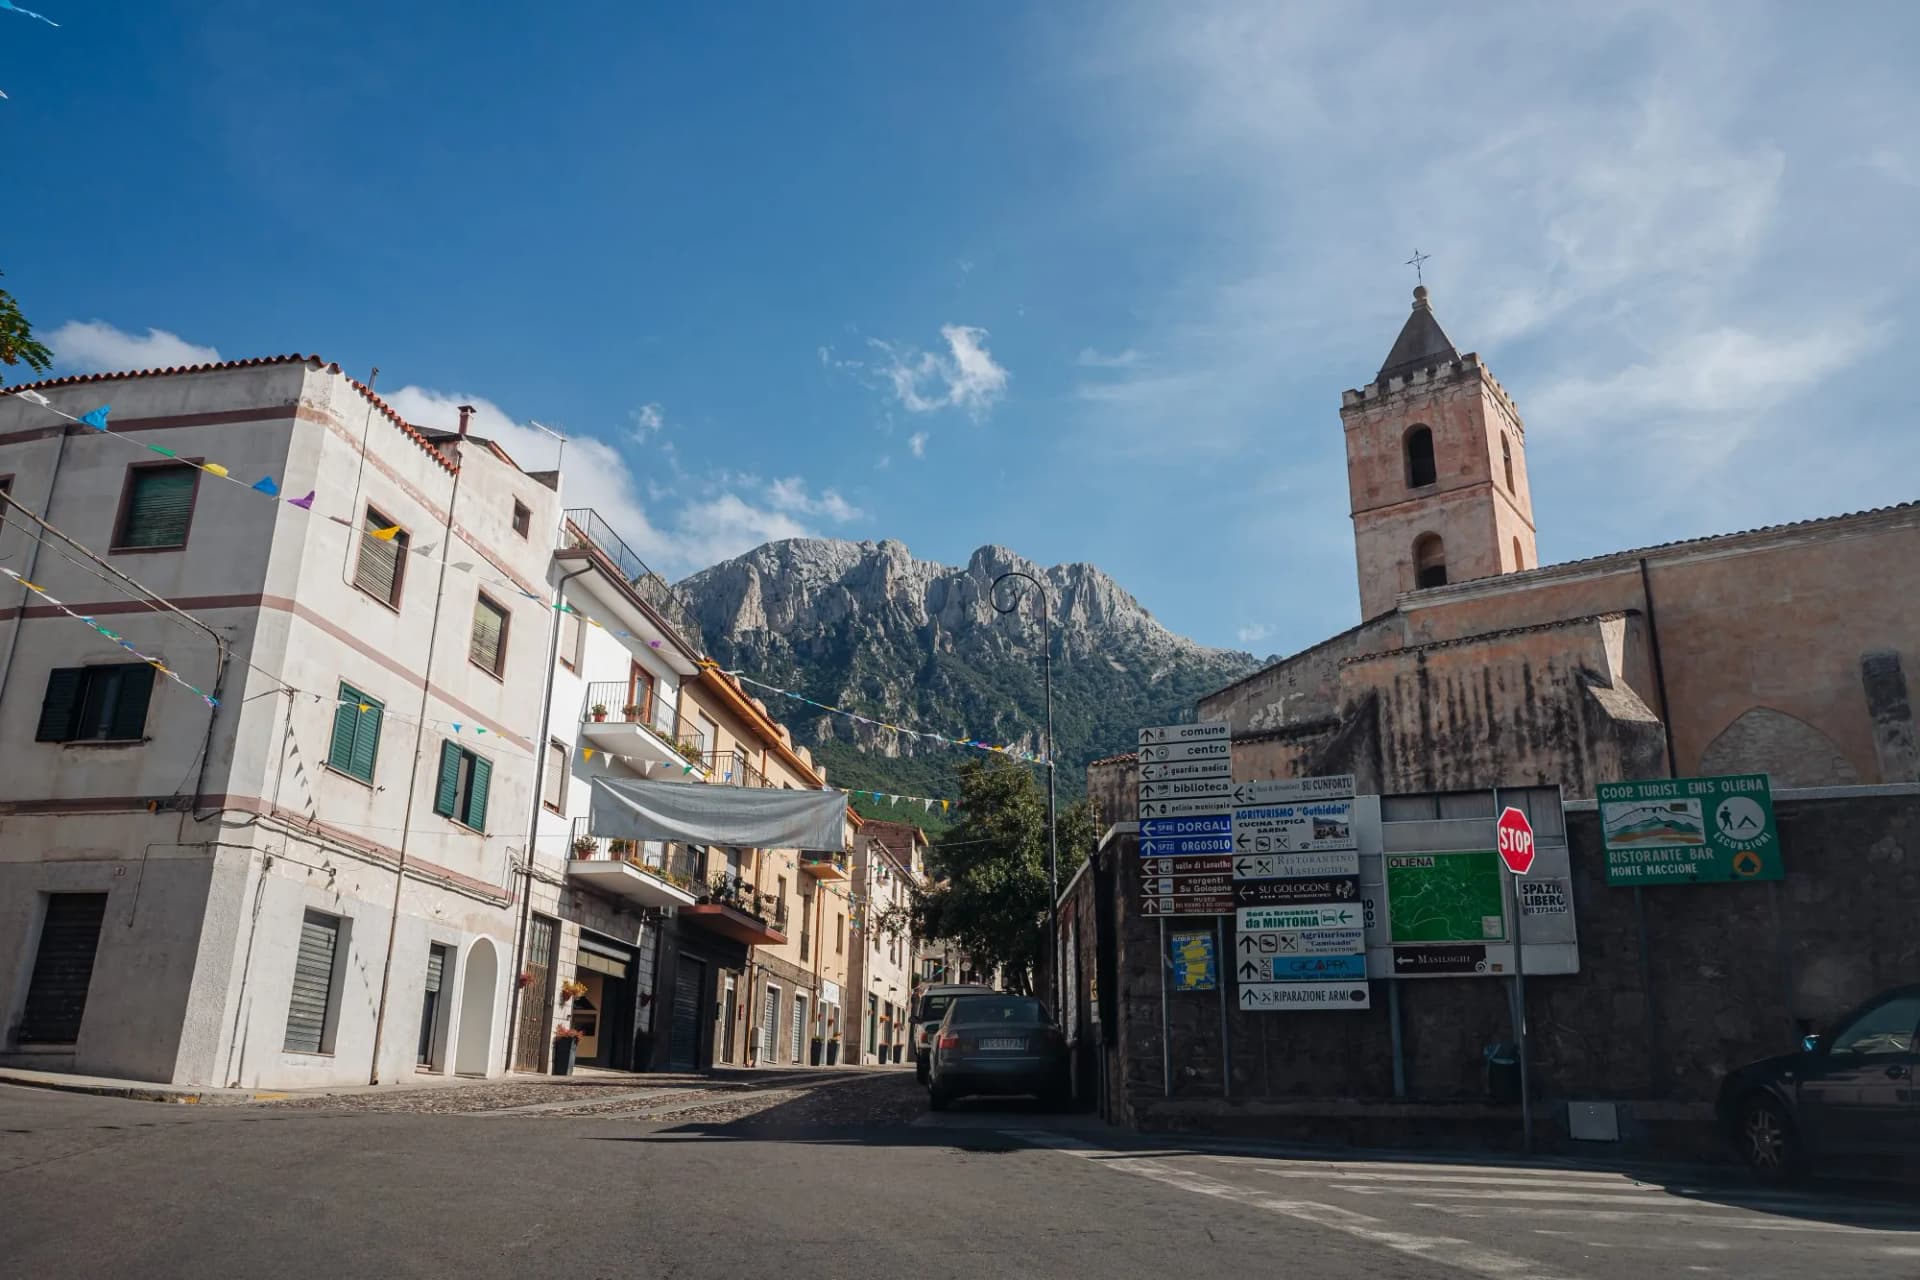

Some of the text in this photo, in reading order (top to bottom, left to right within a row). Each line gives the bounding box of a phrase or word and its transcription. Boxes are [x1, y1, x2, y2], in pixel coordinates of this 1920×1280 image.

[1180, 727, 1225, 737] comune
[1187, 745, 1226, 755] centro
[1171, 764, 1228, 776] guardia medica
[1174, 783, 1229, 793] biblioteca
[1302, 781, 1312, 791] SU
[1313, 777, 1352, 790] CUNFORTU
[1638, 782, 1681, 797] TURIST.
[1687, 781, 1715, 795] ENIS
[1721, 778, 1765, 792] OLIENA
[1235, 807, 1294, 820] AGRITURISMO
[1177, 820, 1231, 833] DORGALI
[1238, 820, 1273, 828] CUCINA
[1181, 839, 1231, 851] ORGOSOLO
[1499, 826, 1531, 855] STOP
[1713, 831, 1772, 851] ESCURSIONI
[1391, 857, 1433, 867] OLIENA
[1608, 848, 1715, 865] RISTORANTE BAR
[1193, 860, 1201, 869] di
[1610, 863, 1698, 877] MONTE MACCIONE
[1188, 876, 1224, 886] sorgenti
[1179, 885, 1232, 893] Su Gologone
[1259, 884, 1271, 894] SU
[1246, 916, 1319, 928] da MINTONIA
[1300, 931, 1362, 941] Agriturismo
[1274, 990, 1350, 1002] RIPARAZIONE ARMI
